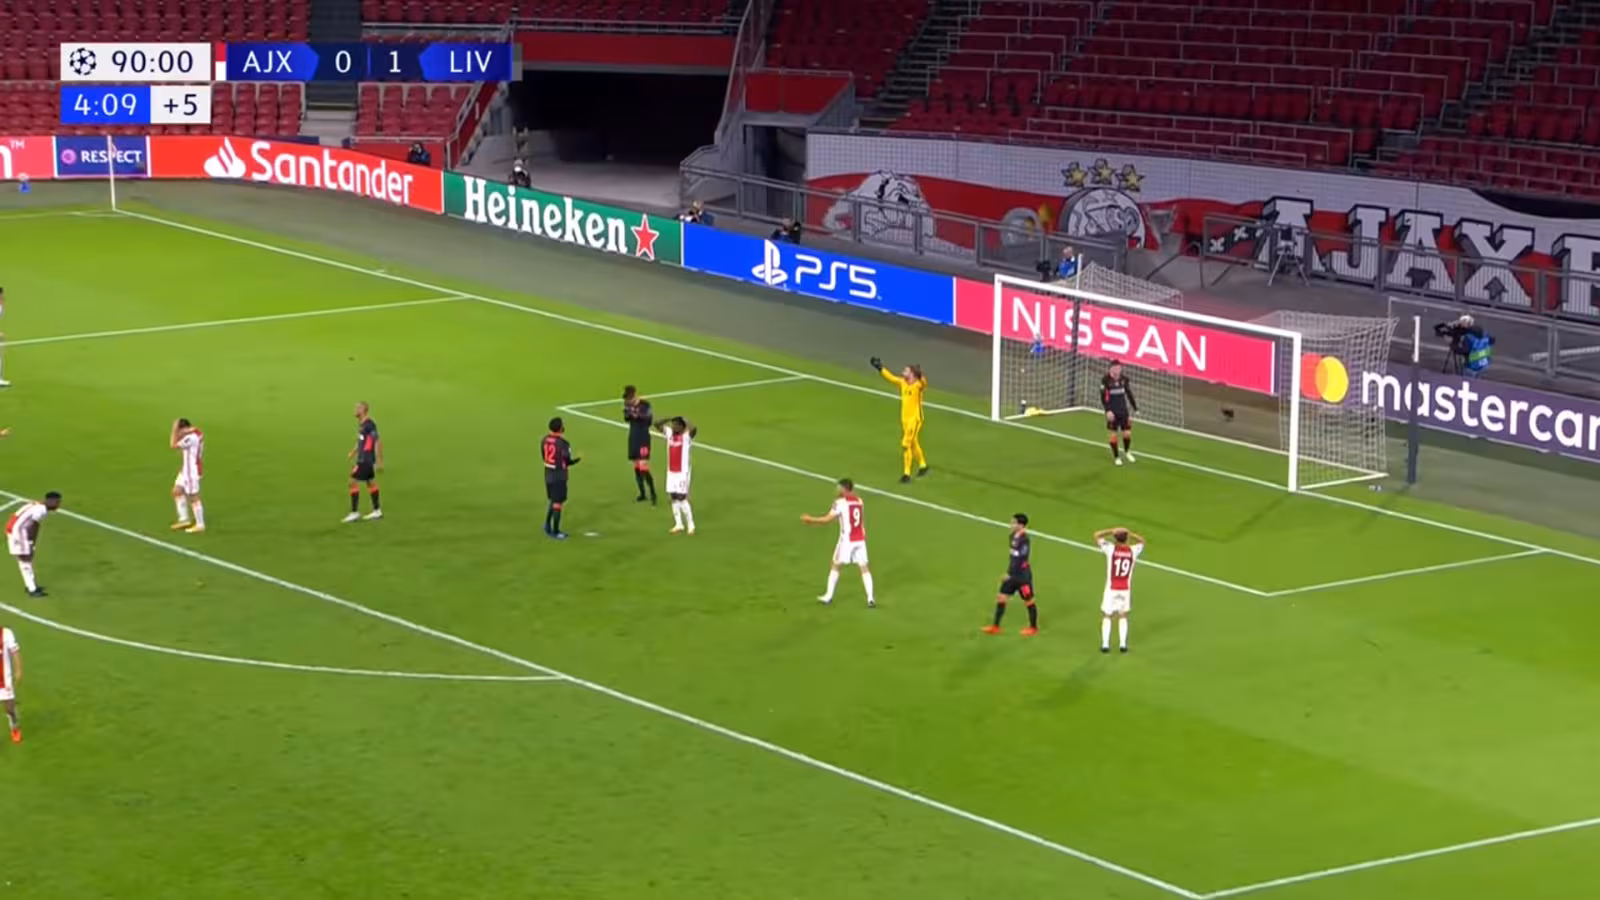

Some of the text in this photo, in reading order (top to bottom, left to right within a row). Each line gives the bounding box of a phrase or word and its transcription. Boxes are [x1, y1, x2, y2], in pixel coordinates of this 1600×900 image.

[250, 143, 413, 204] Santander
[462, 175, 628, 254] Heineken
[795, 253, 877, 299] PS5
[1012, 297, 1207, 372] NISSAN
[543, 443, 556, 464] 12
[853, 507, 860, 528] 9
[1114, 558, 1130, 577] 19
